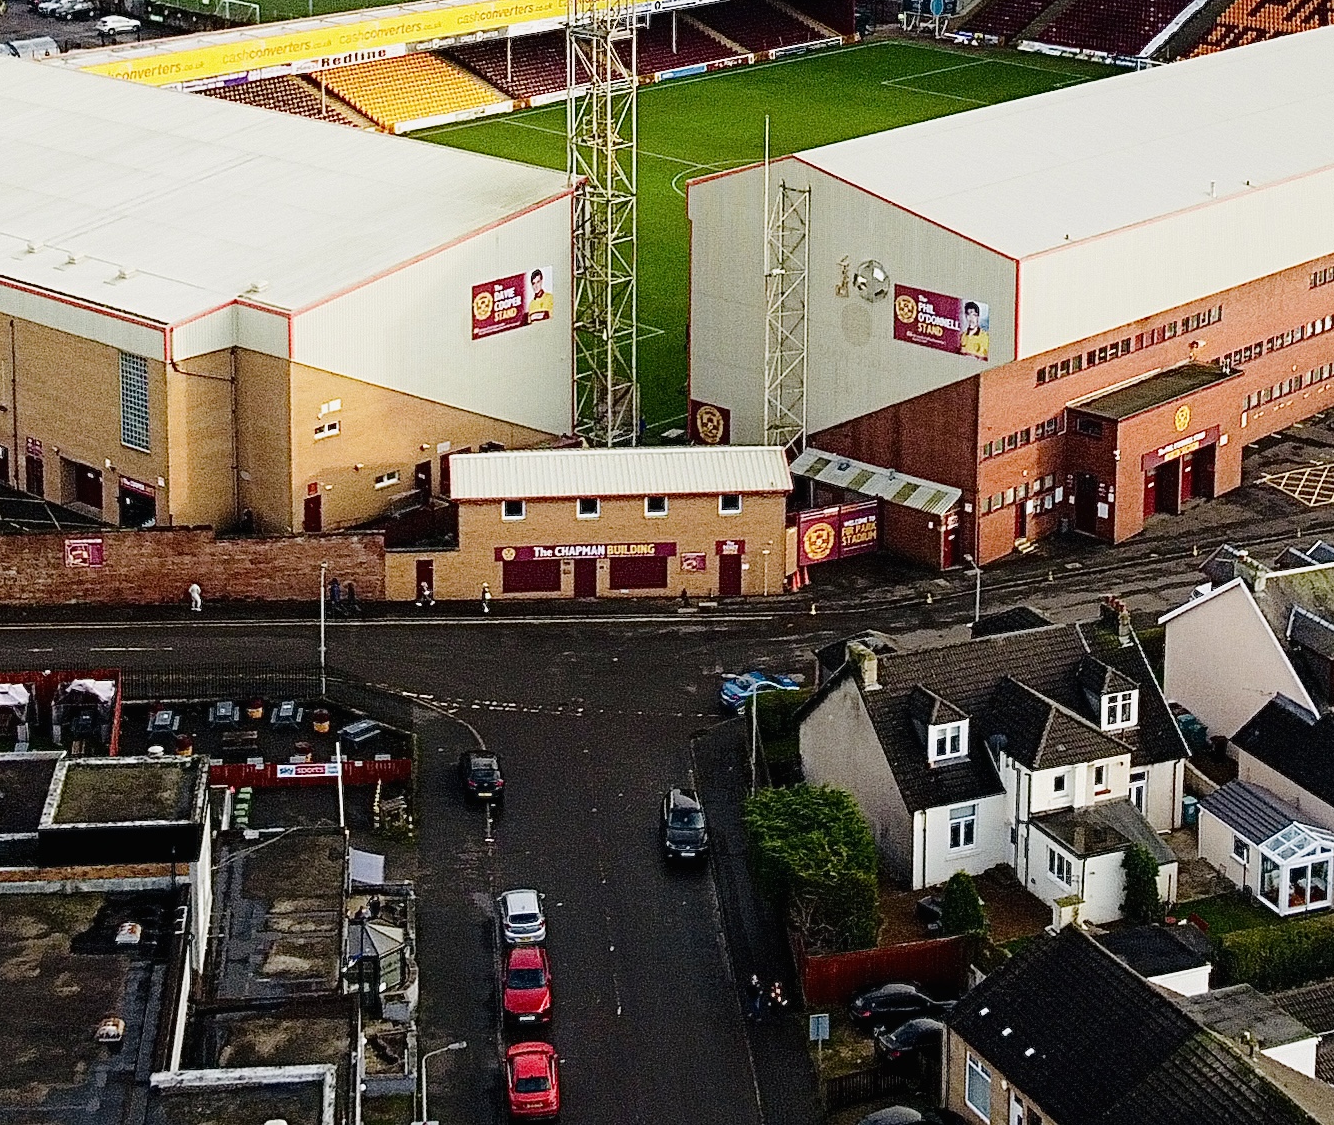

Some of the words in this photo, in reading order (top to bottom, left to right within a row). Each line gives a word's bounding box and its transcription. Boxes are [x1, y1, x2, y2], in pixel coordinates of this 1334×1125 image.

[321, 48, 387, 68] Redline
[918, 302, 935, 315] PHIL
[917, 322, 943, 337] STAND
[533, 546, 553, 558] The
[554, 544, 606, 558] CHAPMAN
[607, 543, 656, 556] BUILDING
[279, 767, 294, 776] sky
[296, 767, 324, 775] sports
